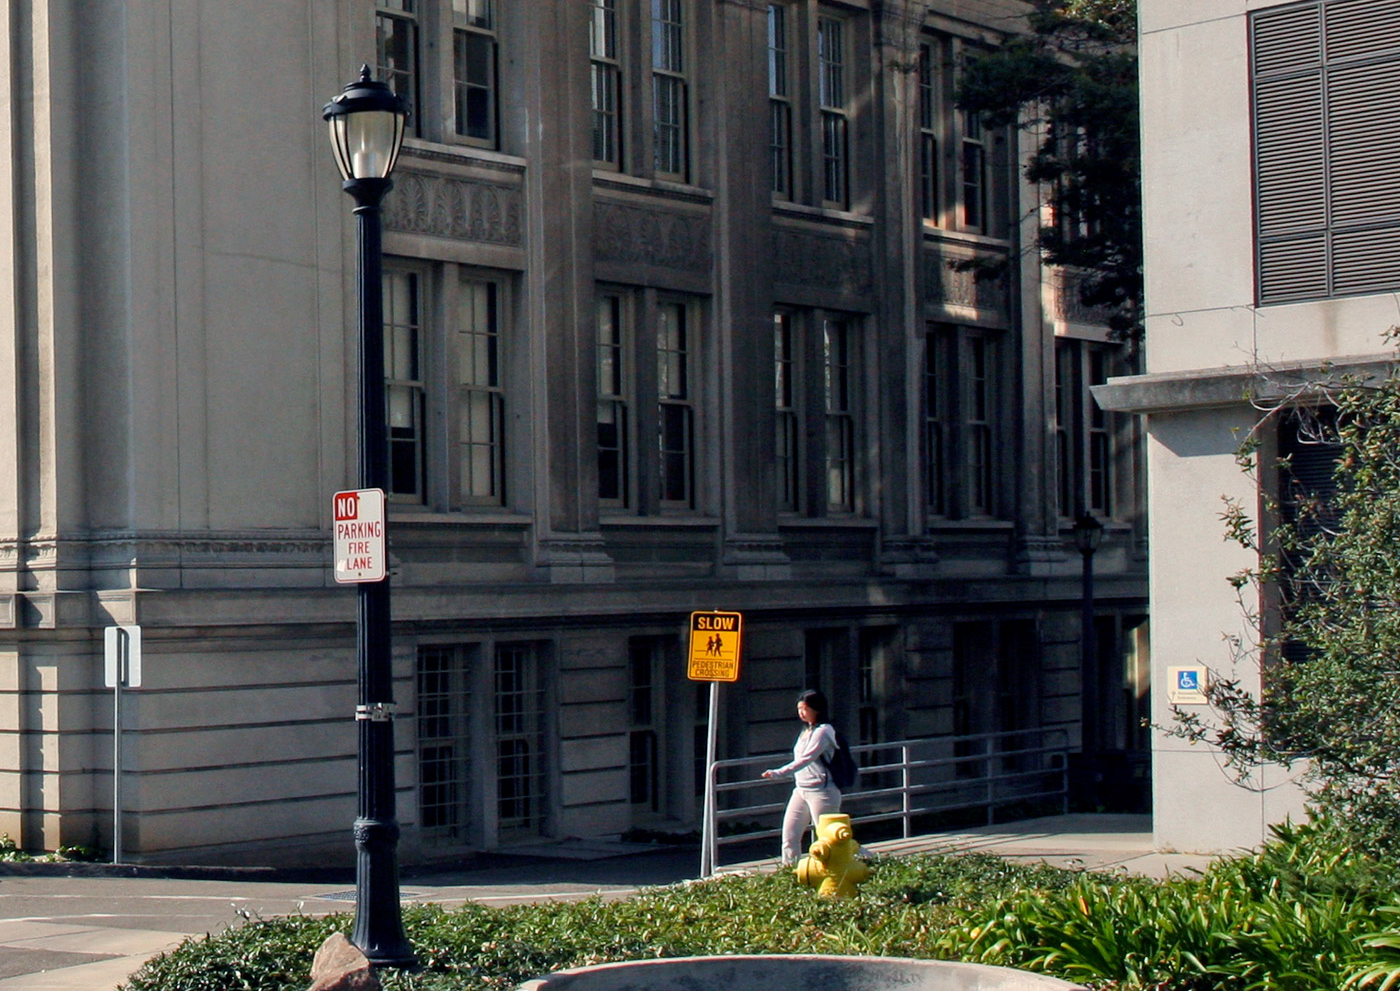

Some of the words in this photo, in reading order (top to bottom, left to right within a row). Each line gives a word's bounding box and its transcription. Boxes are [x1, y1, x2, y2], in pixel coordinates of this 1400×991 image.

[338, 497, 355, 517] NO
[338, 521, 381, 540] PARKING
[348, 541, 370, 555] FIRE
[346, 557, 372, 570] LANE
[698, 617, 734, 629] SLOW
[692, 661, 733, 669] PEDESTRIAN
[695, 669, 729, 677] CROSSING
